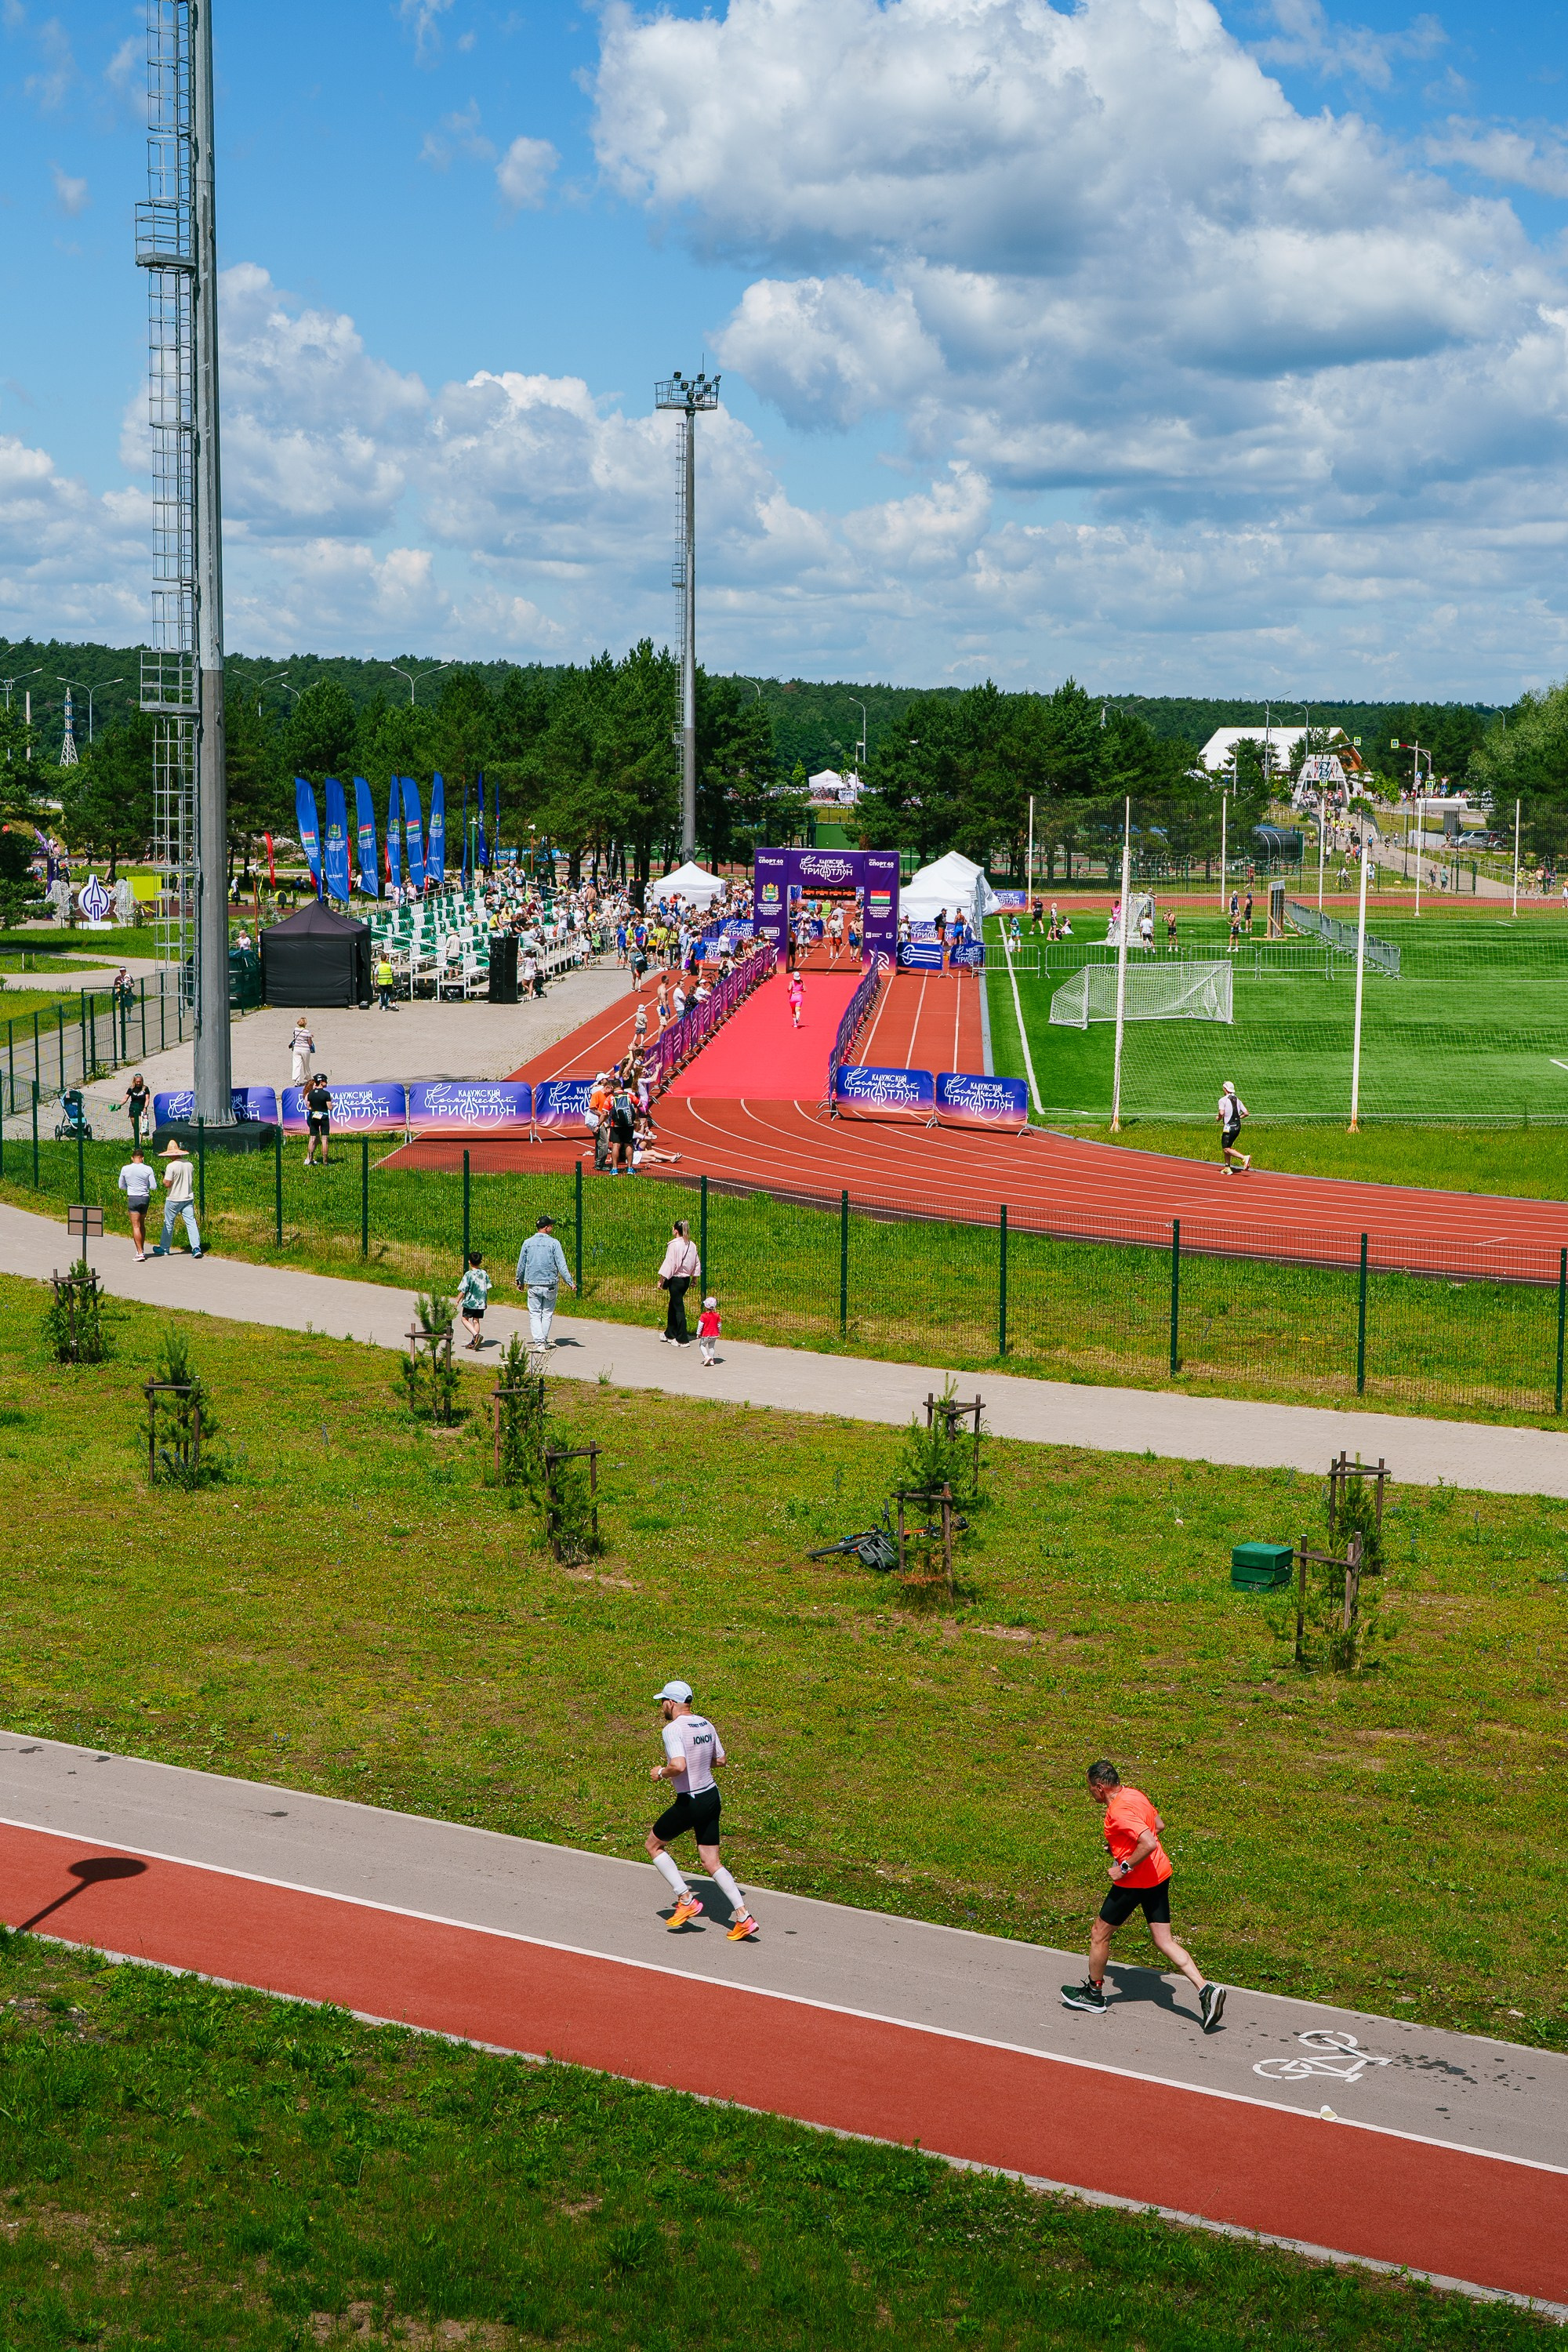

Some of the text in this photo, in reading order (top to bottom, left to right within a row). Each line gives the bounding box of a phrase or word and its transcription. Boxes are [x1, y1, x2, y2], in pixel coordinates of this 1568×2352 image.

[872, 1073, 907, 1083] КАЛУЖСКИЙ
[970, 1082, 1003, 1091] КАЛУЖСКИЙ
[330, 1090, 372, 1099] КАЛУЖСКИЙ
[458, 1088, 501, 1098] КАЛУЖСКИЙ
[693, 1733, 713, 1745] IONOV
